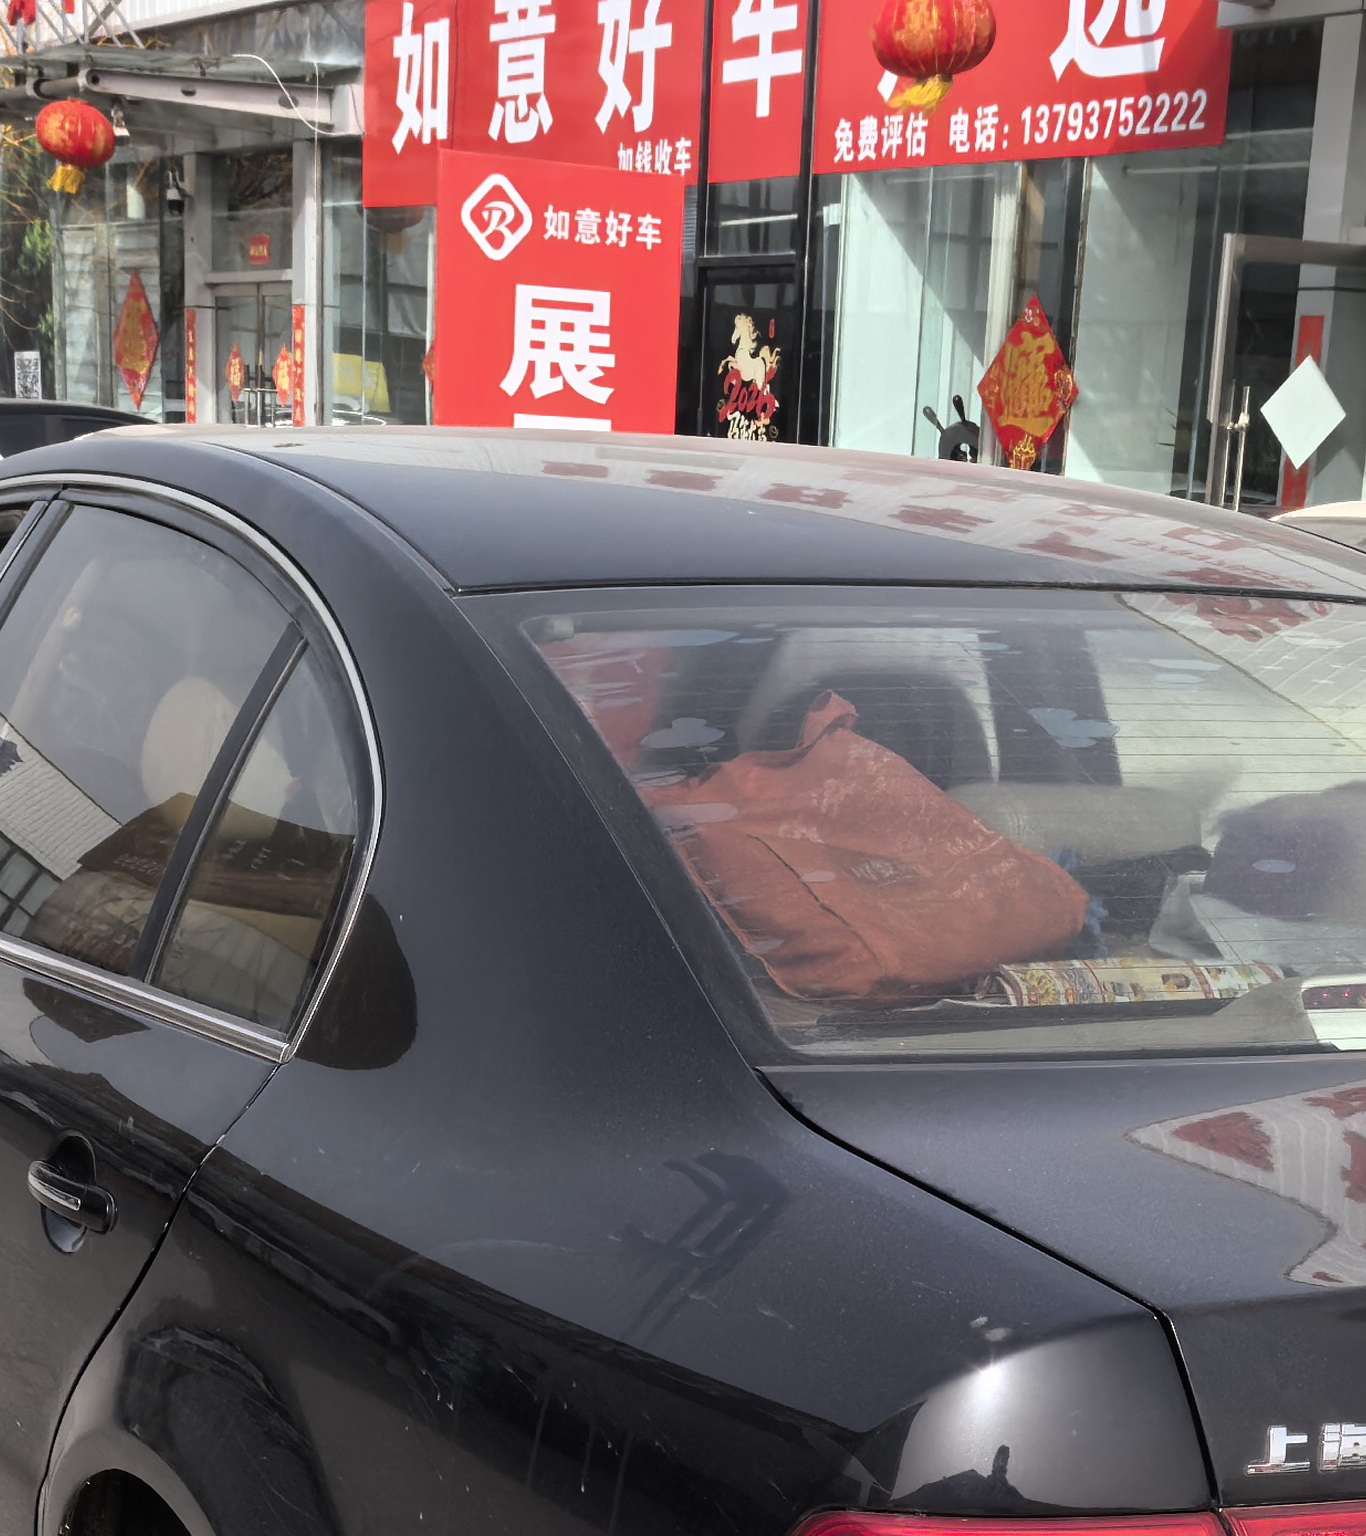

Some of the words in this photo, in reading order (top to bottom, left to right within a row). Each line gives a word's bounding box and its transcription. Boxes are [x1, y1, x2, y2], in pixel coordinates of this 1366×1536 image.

[618, 137, 692, 176] 加钱收车
[834, 111, 929, 162] 免费评估
[543, 205, 662, 250] 如意好车
[499, 283, 616, 432] 展
